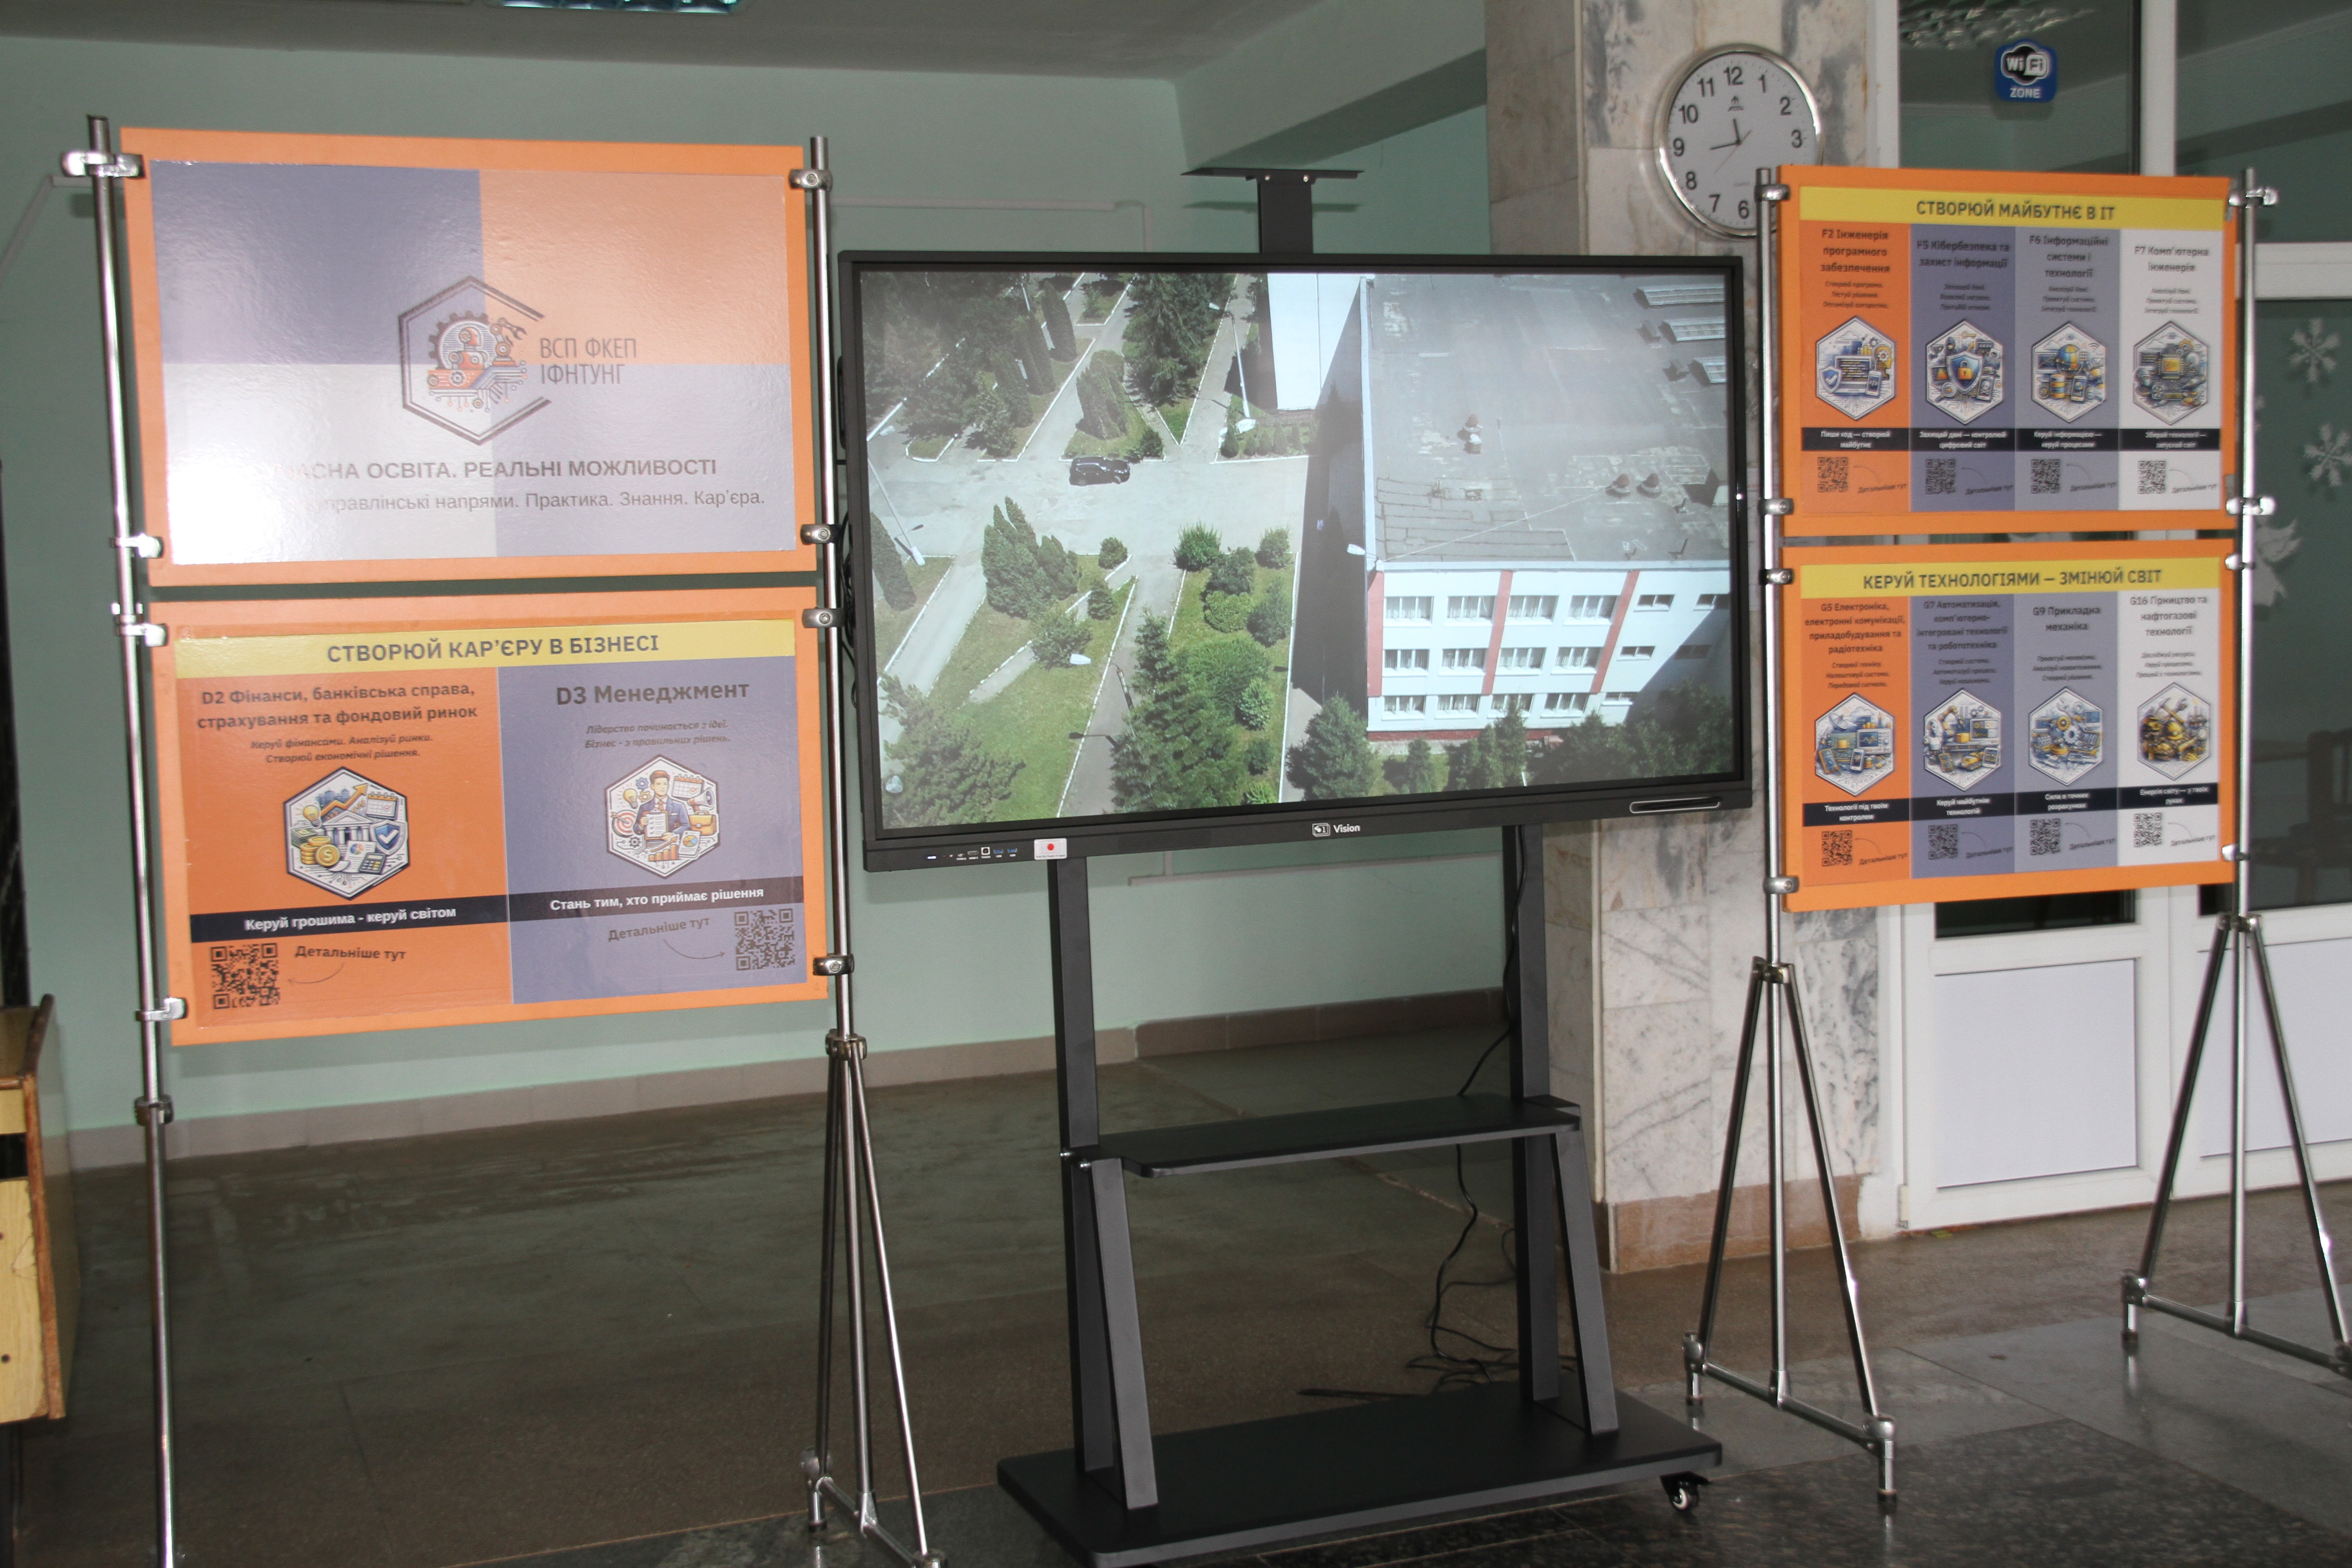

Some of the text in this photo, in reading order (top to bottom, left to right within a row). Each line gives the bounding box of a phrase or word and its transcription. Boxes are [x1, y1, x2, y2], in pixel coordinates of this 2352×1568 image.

[1723, 66, 1743, 86] 12
[1697, 78, 1714, 98] 11
[1758, 74, 1765, 93] 1
[2010, 88, 2041, 98] ZONE
[1779, 96, 1791, 116] 2
[1679, 104, 1698, 124] 10
[1791, 129, 1802, 148] 3
[1673, 138, 1684, 157] 9
[1685, 172, 1697, 190] 8
[1708, 194, 1720, 213] 7
[1738, 200, 1749, 219] 6
[1916, 200, 1994, 216] СТВОРЮЙ
[1999, 201, 2081, 220] МАЙБУТНЄ
[2087, 206, 2095, 220] В
[1822, 230, 1888, 241] F2 Інженерія
[2029, 235, 2108, 247] F6 Інформаційні
[1823, 247, 1886, 257] програмного
[1917, 240, 2009, 252] F5 Кібербезпека та
[2135, 246, 2145, 255] F7
[1919, 258, 2008, 268] захист інформації
[2047, 253, 2085, 262] системи
[1820, 263, 1890, 273] забезпечення
[2045, 268, 2093, 278] технології
[2148, 262, 2195, 273] інженерія
[541, 338, 637, 358] ВСП ФКЕП
[542, 364, 625, 384] ІФНТУНГ
[368, 463, 456, 479] ОСВІТА.
[465, 461, 561, 478] РЕАЛЬНІ
[569, 460, 716, 476] МОЖЛИВОСТІ
[436, 496, 518, 512] напрями.
[525, 493, 613, 511] Практика.
[620, 491, 688, 507] Знання.
[1863, 567, 2161, 589] КЕРУЙ ТЕХНОЛОГІЯМИ ЗМІНЮЙ СВІТ
[1924, 601, 1934, 609] G7
[2130, 597, 2147, 605] G16
[2150, 596, 2195, 606] Гірництво
[1821, 603, 1832, 612] G5
[2033, 606, 2100, 616] G9 Прикладна
[1805, 617, 1852, 627] електронні
[2141, 611, 2196, 622] нафтогазові
[1917, 627, 2007, 638] інтегровані технології
[2046, 622, 2088, 631] механіка
[2146, 626, 2192, 636] технології
[1809, 631, 1891, 641] приладобудування
[328, 638, 441, 662] СТВОРЮЙ
[550, 639, 563, 655] В
[571, 635, 658, 654] БІЗНЕСІ
[1828, 644, 1882, 654] радіотехніка
[1938, 641, 1997, 651] робототехніка
[202, 684, 475, 705] D2 Фінанси, банківська справа,
[557, 684, 750, 706] D3 Менеджмент
[198, 706, 477, 732] страхування та фондовий ринок
[587, 723, 635, 734] Лідерство
[637, 722, 698, 732] починається
[251, 734, 433, 751] Керуй фінансами. Аналізуй ринки.
[585, 739, 616, 749] Бізнес
[633, 737, 691, 748] правильних
[267, 749, 420, 764] Створюй економічні рішення.
[1825, 804, 1857, 812] Технології
[1936, 799, 1955, 807] Керуй
[2048, 803, 2087, 811] розрахунках
[1946, 808, 1980, 816] технологій
[1333, 824, 1360, 833] Vision
[550, 887, 764, 911] Стань тим, хто приймає рішення
[245, 907, 456, 932] Керуй грошима керуй світом
[608, 917, 710, 943] Детальніше тут
[295, 946, 406, 961] Детальніше тут
